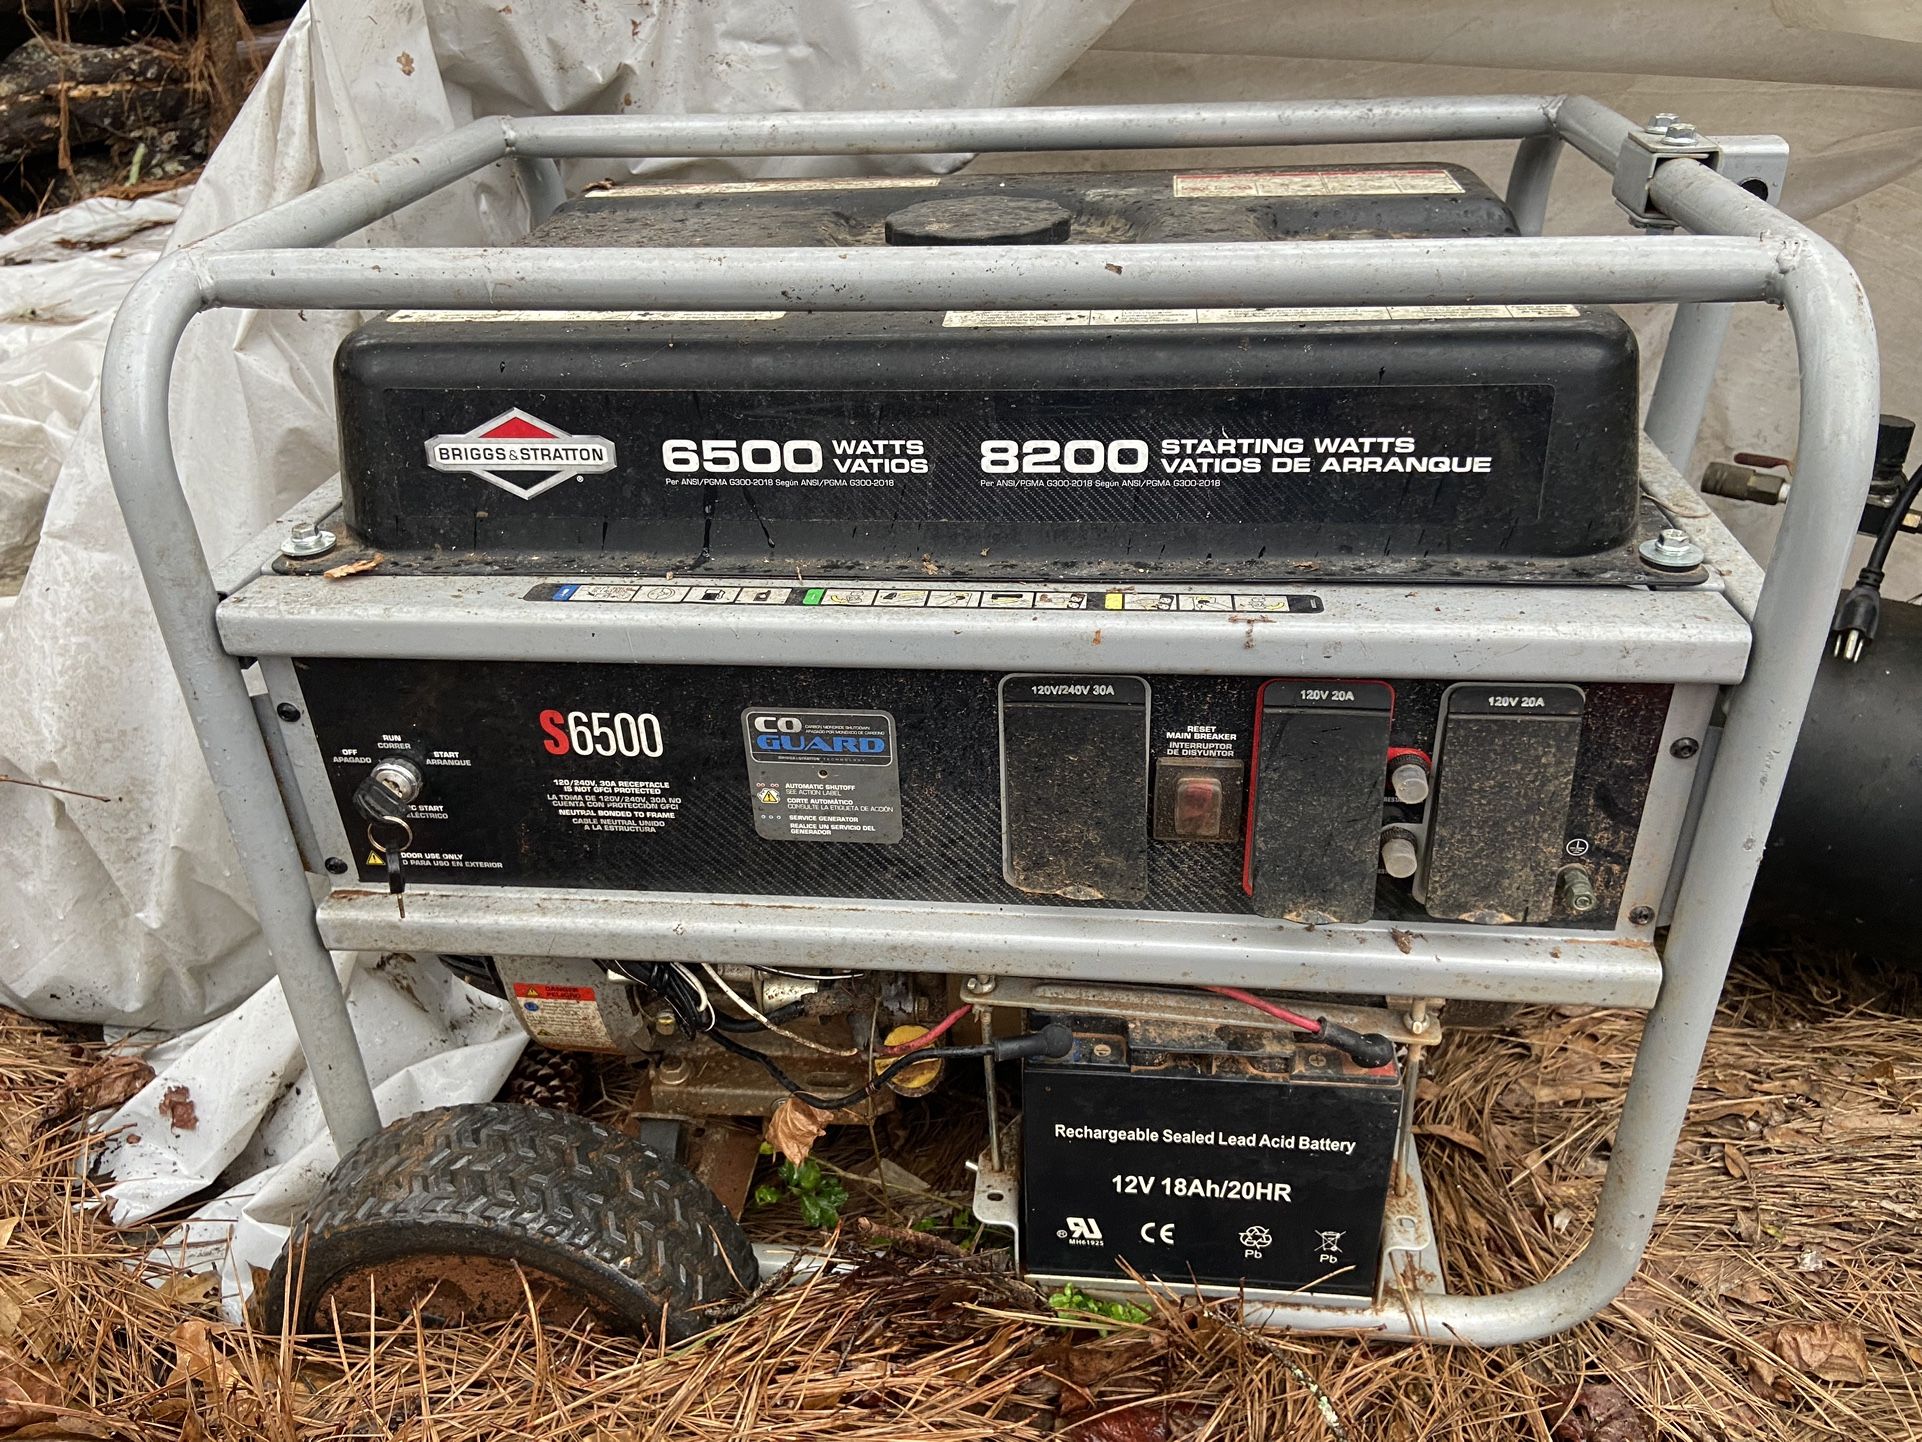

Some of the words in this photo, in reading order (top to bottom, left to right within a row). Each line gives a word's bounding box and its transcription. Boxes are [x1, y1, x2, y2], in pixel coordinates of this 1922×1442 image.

[832, 440, 925, 455] WATTS
[1161, 438, 1304, 454] STARTING
[1313, 437, 1416, 453] WATTS
[661, 439, 824, 473] 6500
[980, 439, 1149, 474] 8200
[833, 458, 929, 473] VATIOS
[1160, 457, 1262, 473] VATIOS
[1271, 457, 1312, 473] DE
[1320, 456, 1493, 473] ARRANQUE
[666, 478, 680, 486] Per
[681, 478, 728, 487] ANSI/PGMA
[729, 478, 774, 487] G300-2018
[775, 478, 799, 488] Según
[801, 478, 848, 487] ANSI/PGMA
[849, 478, 895, 487] G300-2018
[980, 479, 994, 487] Per
[996, 479, 1045, 488] ANSI/PGMA
[1046, 479, 1093, 488] G300-2018
[1094, 479, 1120, 489] Según
[1121, 479, 1171, 488] ANSI/PGMA
[1173, 479, 1221, 488] G300-2018
[1031, 685, 1090, 695] 120V/240V
[1092, 685, 1115, 695] 30A
[1300, 689, 1329, 700] 120V
[1331, 690, 1355, 701] 20A
[1488, 696, 1519, 707] 120V
[1520, 696, 1545, 707] 20A
[754, 717, 803, 733] CO
[1187, 725, 1217, 733] RESET
[382, 734, 402, 742] RUN
[539, 709, 664, 758] S6500
[1193, 733, 1237, 741] BREAKER
[377, 742, 412, 750] CORRER
[756, 734, 886, 753] GUARD
[1169, 741, 1233, 750] INTERRUPTOR
[433, 751, 460, 759] START
[1166, 748, 1180, 756] DE
[1181, 749, 1235, 757] DISYUNTOR
[333, 756, 372, 764] APAGADO
[425, 758, 472, 767] ARRANQUE
[618, 781, 670, 789] RECEPTACLE
[613, 787, 662, 795] PROTECTED
[650, 796, 667, 804] 30A
[647, 811, 676, 819] FRAME
[600, 818, 637, 826] NEUTRAL
[604, 825, 657, 833] ESTRUCTURA
[790, 828, 832, 836] GENERADOR
[464, 861, 503, 869] EXTERIOR
[1054, 1123, 1160, 1143] Rechargeable
[1162, 1129, 1215, 1144] Sealed
[1218, 1131, 1257, 1147] Lead
[1258, 1133, 1296, 1149] Acid
[1299, 1136, 1357, 1155] Battery
[1112, 1174, 1156, 1195] 12V
[1161, 1177, 1292, 1203] 18Ah/20HR
[1068, 1238, 1105, 1246] MH61925
[1244, 1249, 1263, 1259] Pb
[1319, 1253, 1338, 1264] Pb
